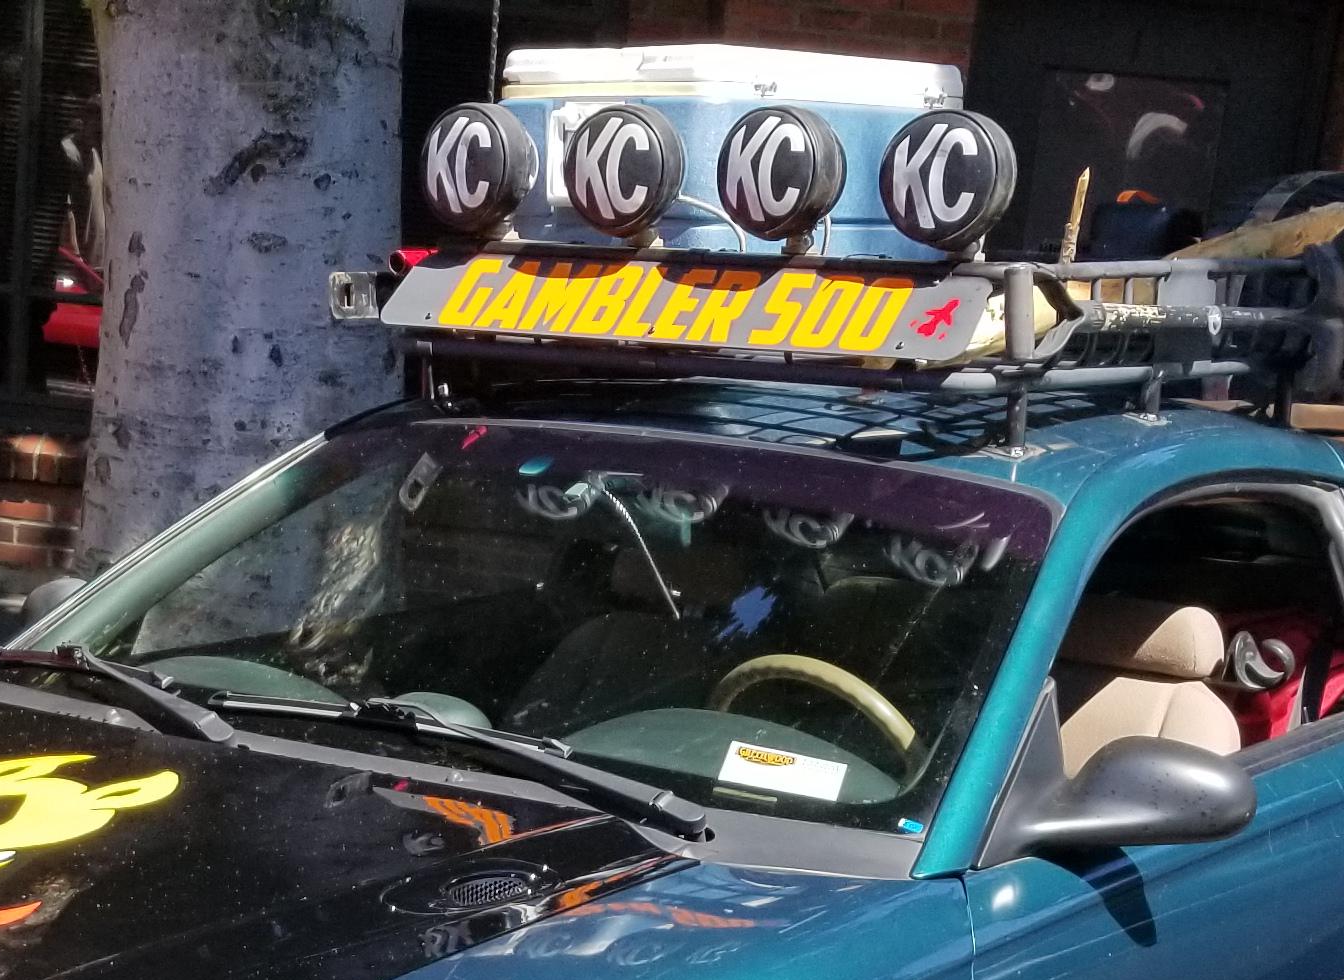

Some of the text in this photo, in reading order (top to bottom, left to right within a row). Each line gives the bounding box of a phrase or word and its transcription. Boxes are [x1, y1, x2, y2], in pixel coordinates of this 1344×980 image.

[426, 117, 492, 213] KC
[575, 117, 650, 220] KC
[726, 116, 806, 222] KC
[893, 124, 978, 229] KC
[438, 258, 915, 352] GAMBLER 500
